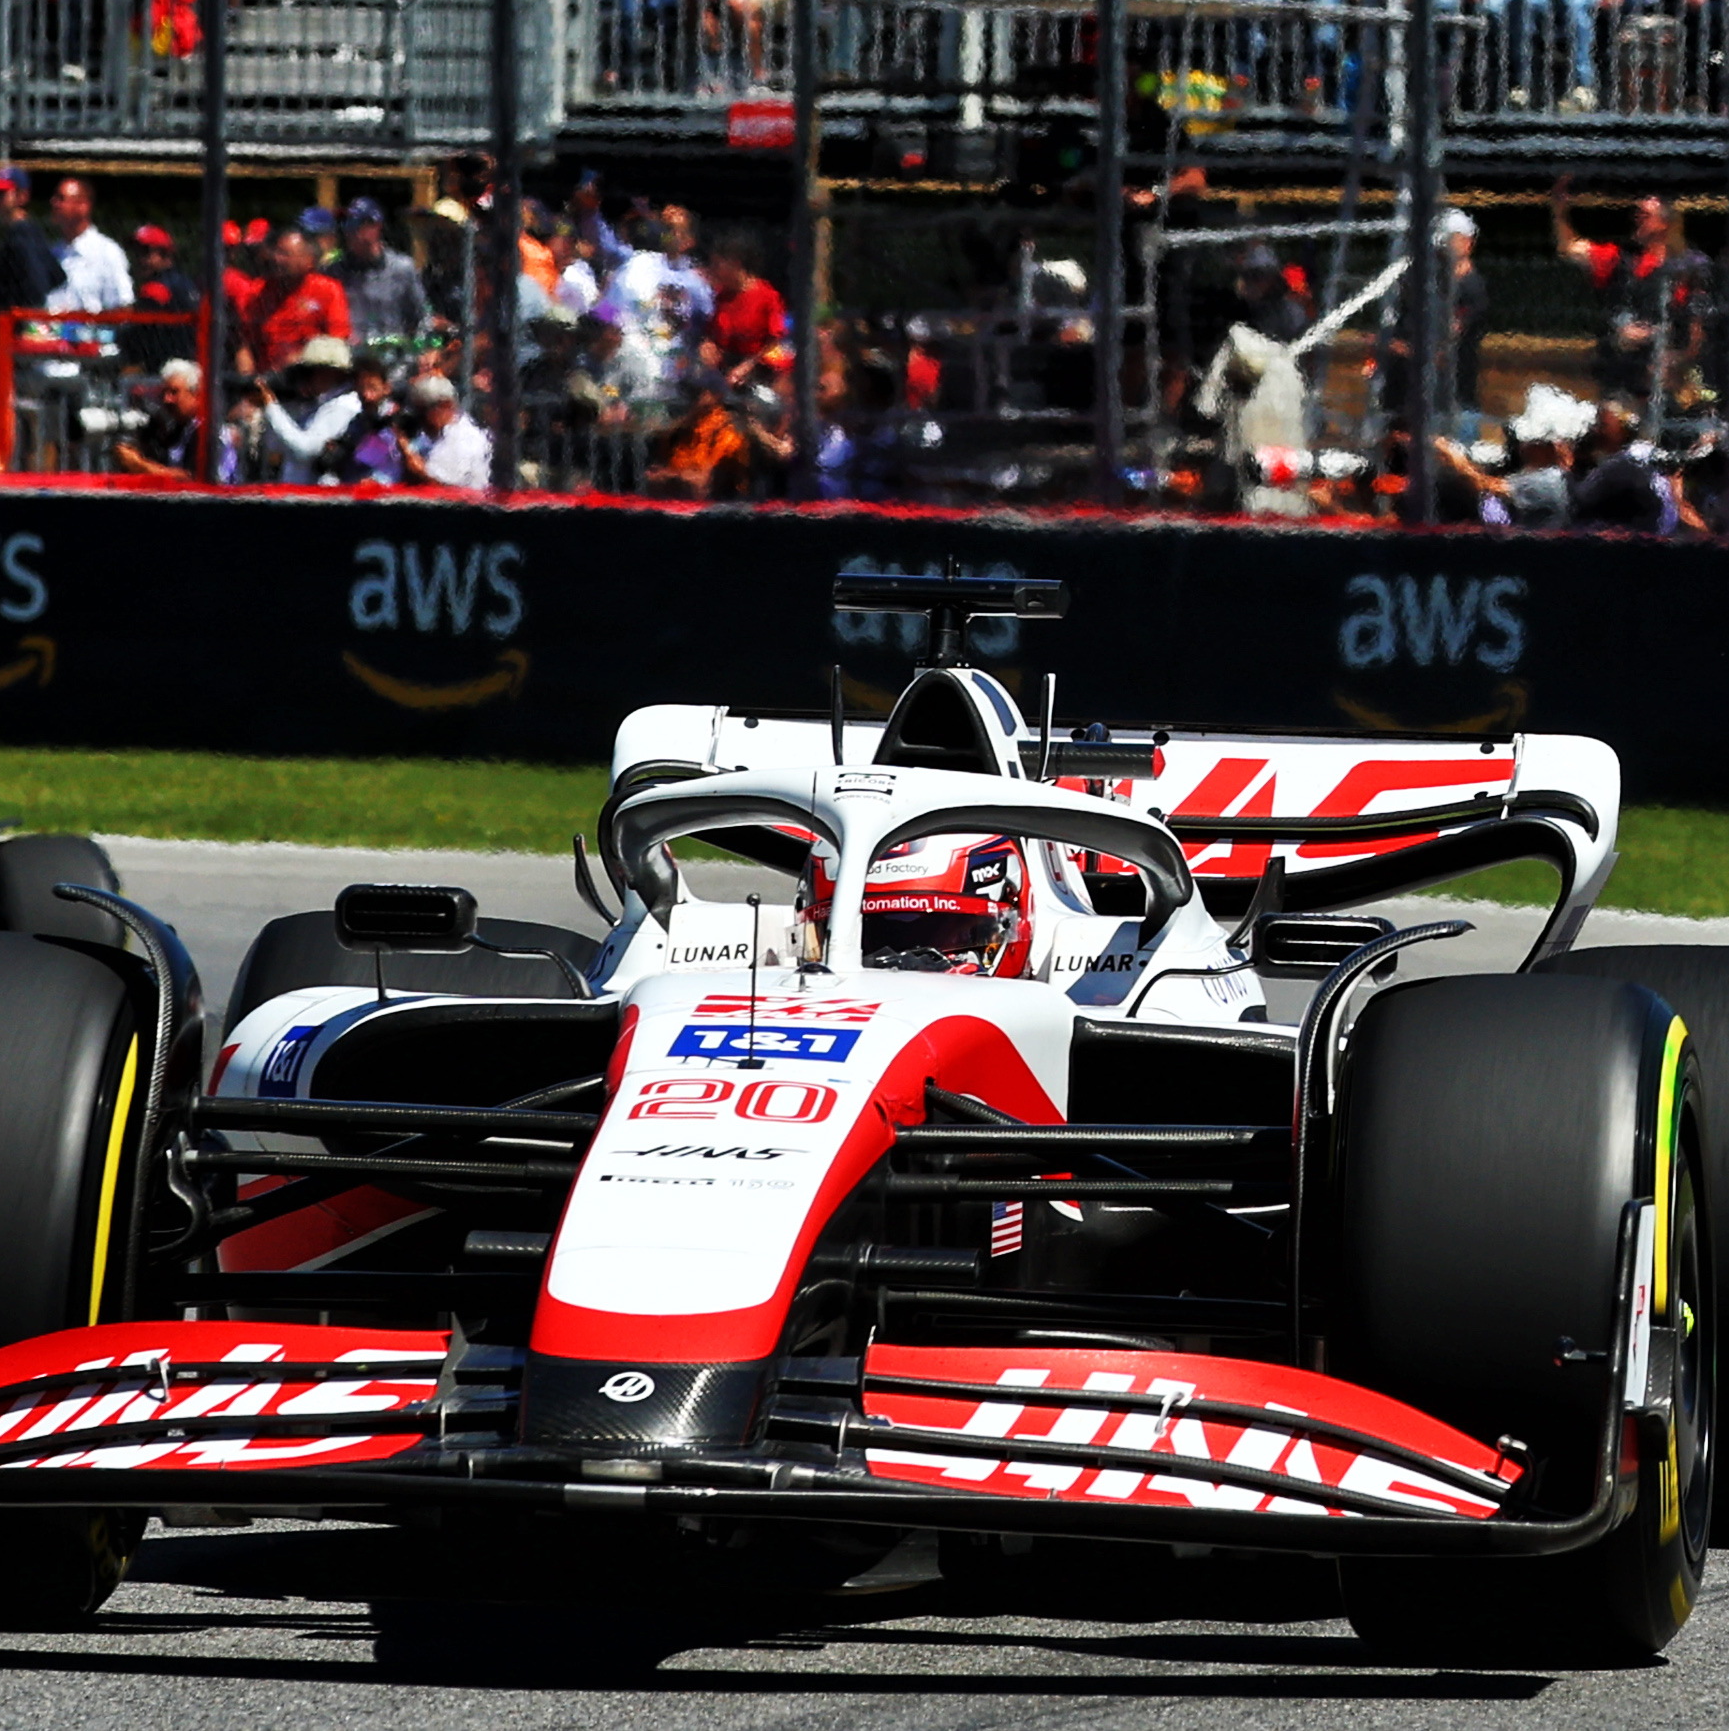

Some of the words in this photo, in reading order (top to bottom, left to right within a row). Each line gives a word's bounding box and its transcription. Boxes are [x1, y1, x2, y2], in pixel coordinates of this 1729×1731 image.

[349, 539, 525, 638] aws
[1338, 573, 1528, 672] aws
[885, 863, 929, 876] Factory
[862, 896, 929, 910] tomation
[934, 896, 961, 910] Inc.
[670, 943, 749, 963] LUNAR
[1054, 953, 1134, 972] LUNAR
[693, 1030, 838, 1054] 1&1
[265, 1039, 309, 1083] 1&1
[627, 1078, 839, 1124] 20
[612, 1144, 809, 1160] HAAS
